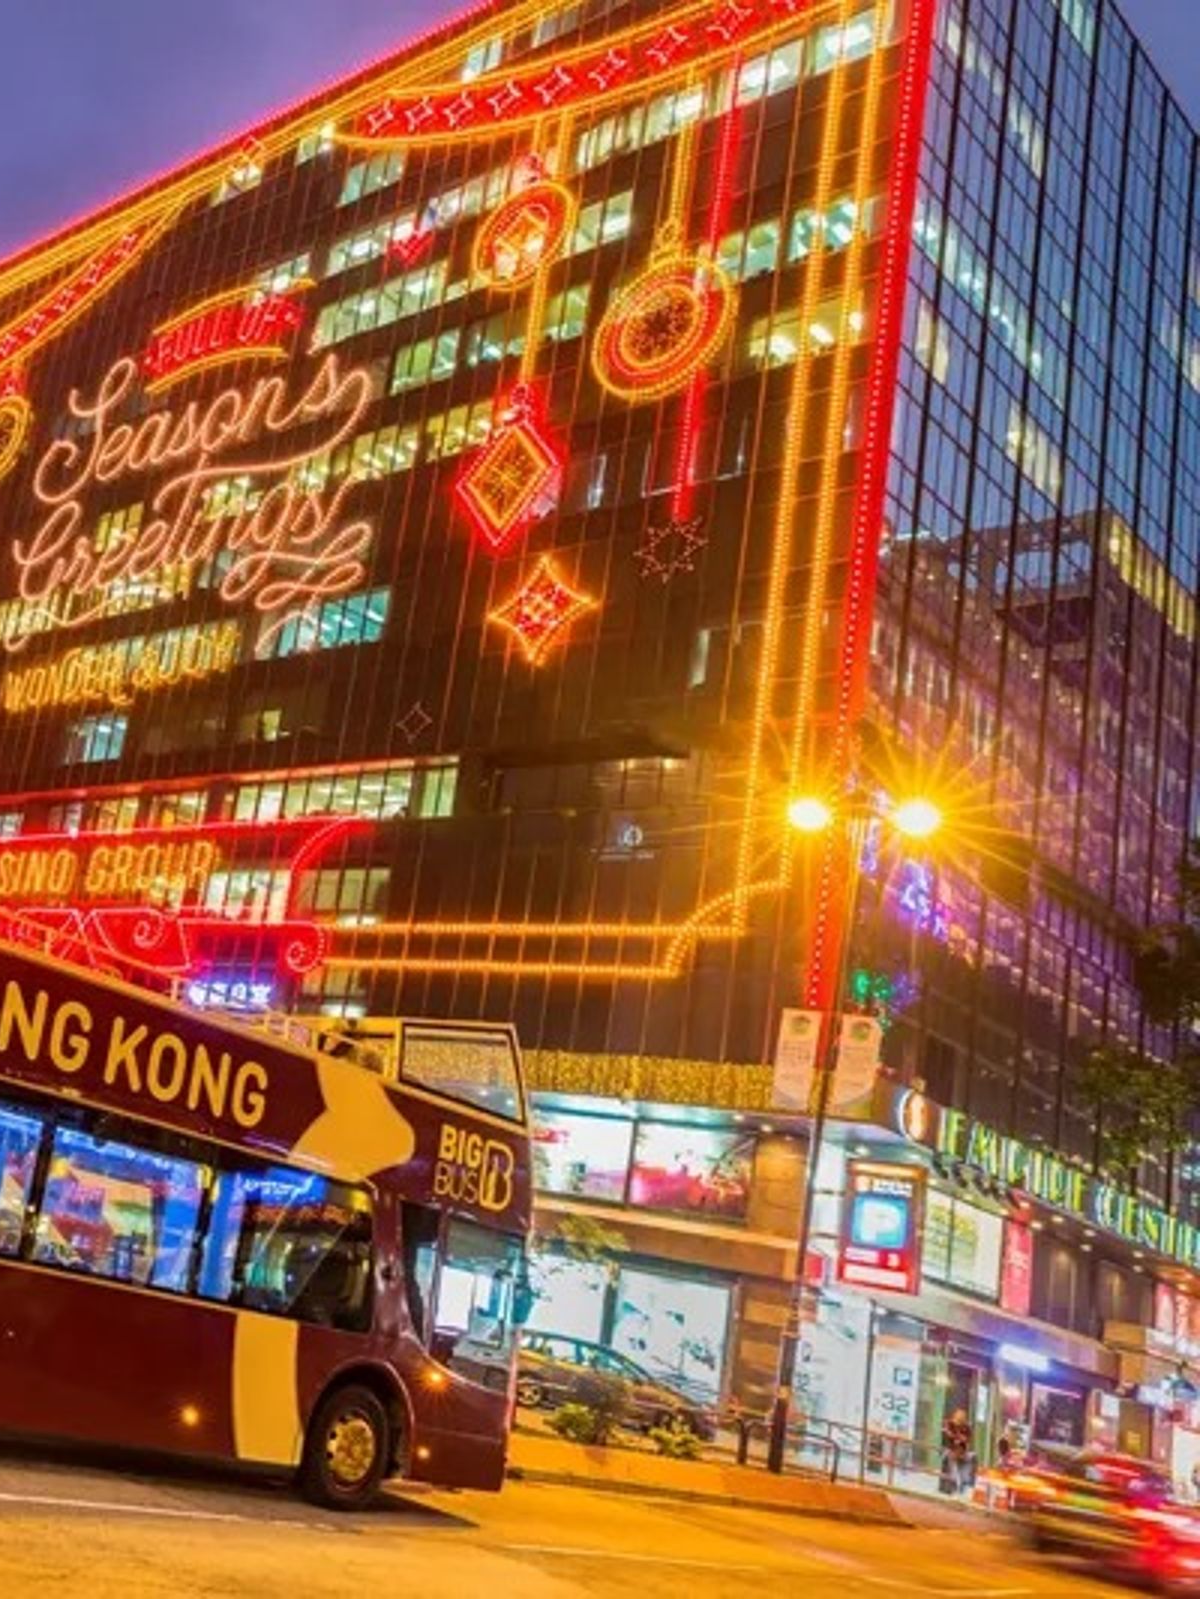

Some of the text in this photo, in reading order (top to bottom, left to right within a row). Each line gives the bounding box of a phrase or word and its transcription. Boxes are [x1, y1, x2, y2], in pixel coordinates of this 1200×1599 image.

[156, 305, 228, 373] FULL
[5, 455, 373, 652] Greetings
[4, 647, 134, 712] WONDER
[85, 841, 216, 894] GROUP
[104, 1016, 269, 1127] KONG
[438, 1123, 483, 1169] BIG
[434, 1161, 478, 1204] BUS
